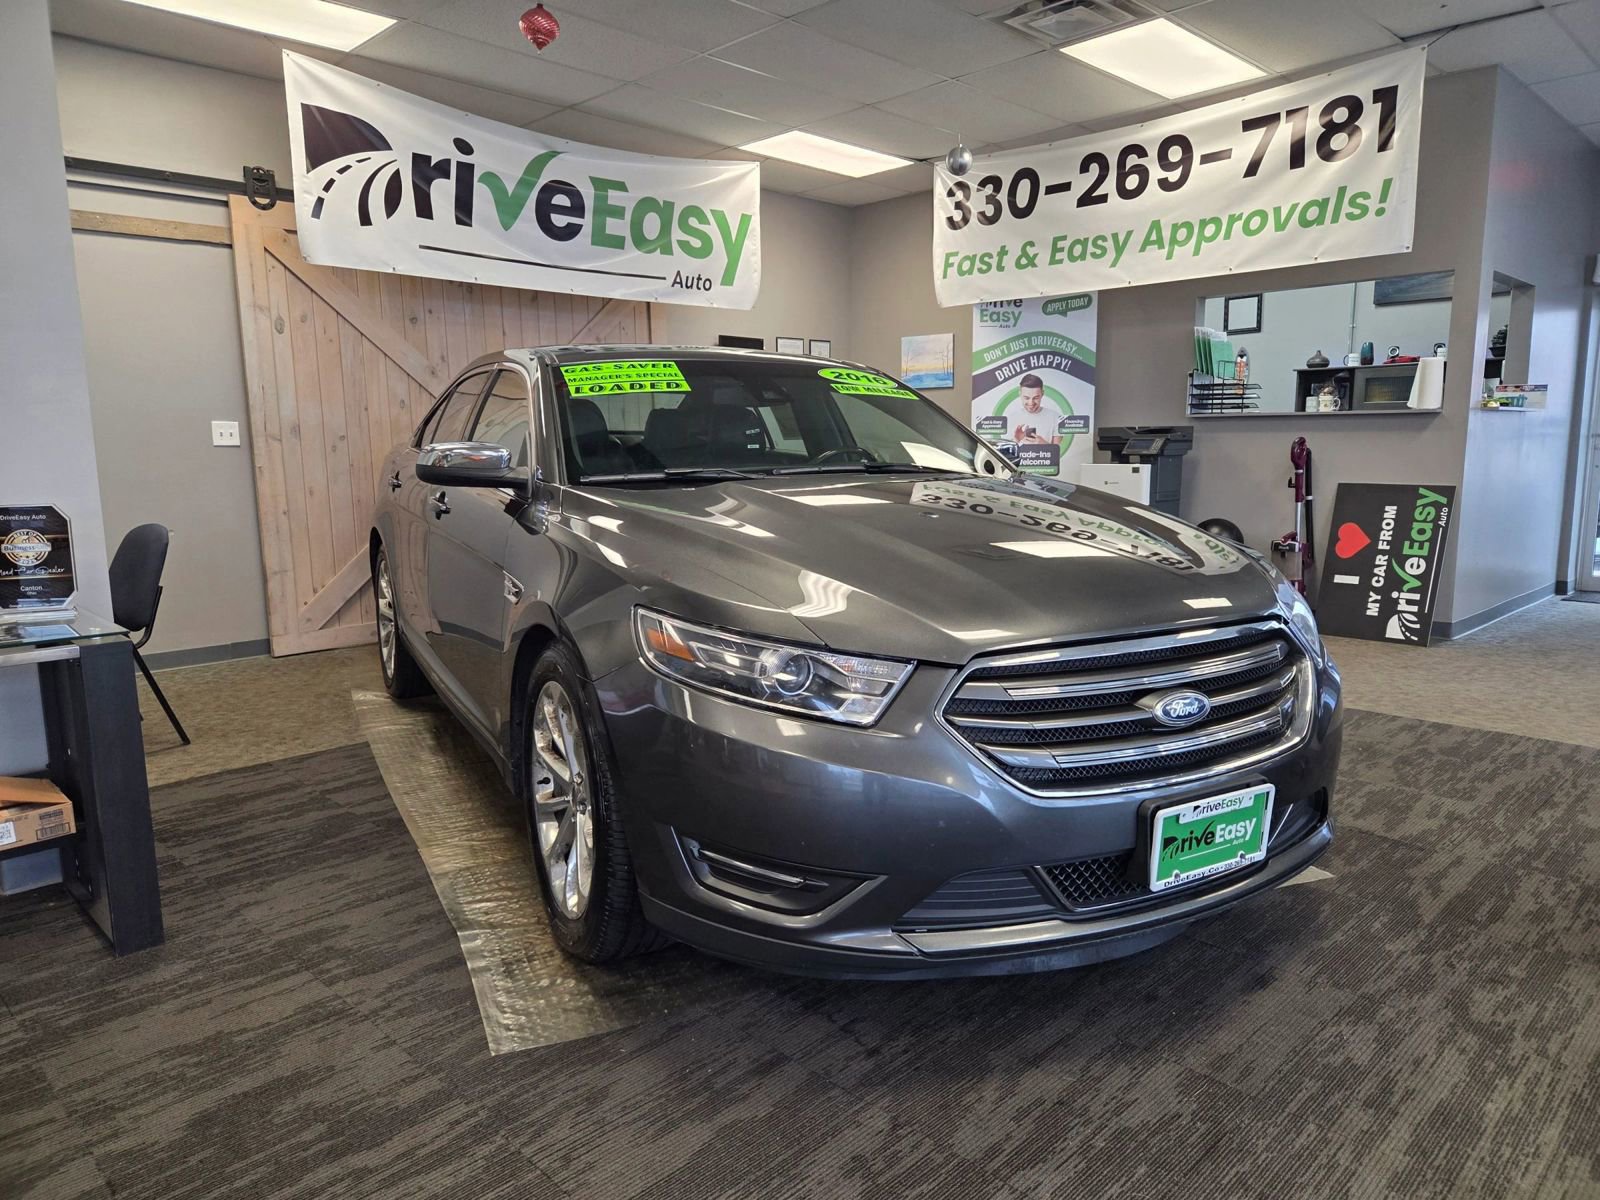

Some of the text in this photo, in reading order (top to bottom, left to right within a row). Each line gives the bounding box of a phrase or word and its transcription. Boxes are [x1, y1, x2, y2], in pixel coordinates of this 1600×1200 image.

[944, 84, 1400, 231] 330-269-7181
[301, 102, 753, 287] DriveEasy
[942, 177, 1394, 279] Fast & Easy Approvals!
[671, 270, 713, 292] Auto
[1046, 297, 1089, 313] APPLY TODAY
[980, 309, 1022, 327] Easy
[983, 346, 1008, 362] DON'T
[1009, 338, 1029, 353] JUST
[568, 371, 679, 383] MANAGER'S SPECIAL
[995, 355, 1071, 381] DRIVE HAPPY!
[574, 381, 682, 394] LOADED
[1438, 507, 1449, 527] Auto
[1365, 505, 1398, 616] MY CAR FROM
[1385, 487, 1448, 641] DriveEasy
[1333, 574, 1360, 585] I
[1165, 698, 1199, 717] Ford
[1192, 795, 1245, 819] DriveEasy
[1162, 817, 1257, 862] DriveEasy
